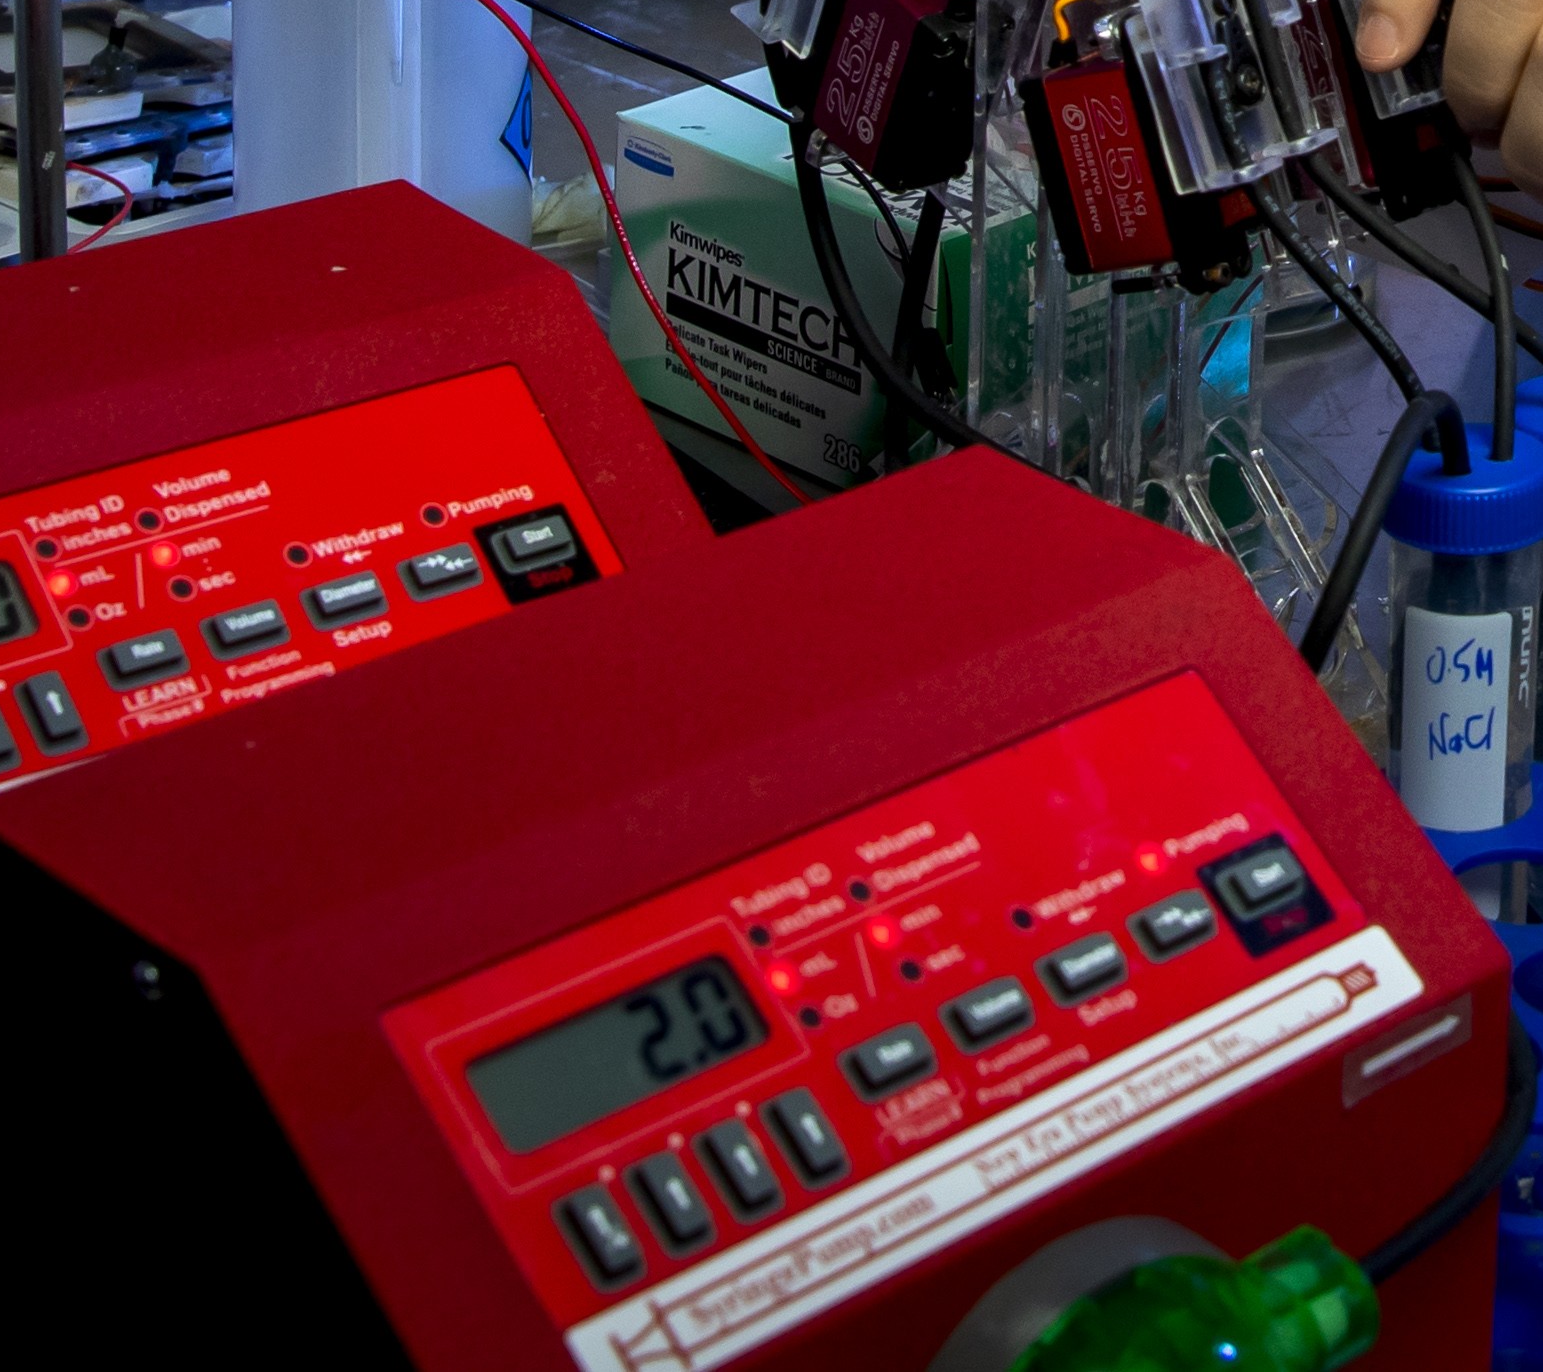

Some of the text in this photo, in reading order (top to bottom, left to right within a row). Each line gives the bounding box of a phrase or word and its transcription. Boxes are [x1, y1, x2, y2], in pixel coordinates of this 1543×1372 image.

[862, 62, 883, 115] DSSERVO
[870, 40, 900, 122] DIGITAL SERVO
[1070, 134, 1102, 233] DIGITAL SERVO
[1081, 133, 1102, 195] DSSERVO
[669, 220, 743, 268] Kimwipes
[708, 337, 730, 358] Task
[732, 347, 768, 375] Wipers
[767, 339, 856, 391] SCIENCE BRAND
[720, 383, 750, 406] tareas
[753, 399, 802, 429] delicadas
[721, 366, 742, 382] pour
[744, 373, 777, 399] tâches
[780, 389, 826, 420] délicates
[824, 433, 861, 474] 286
[152, 468, 231, 499] Volume
[163, 480, 271, 523] Dispensed
[447, 484, 534, 518] Pumping
[25, 494, 125, 534] Tubing ID
[521, 525, 554, 545] Start
[61, 522, 132, 552] inches
[182, 535, 222, 558] min
[311, 521, 405, 558] Withdraw
[78, 566, 115, 587] mL
[199, 570, 237, 593] sec
[95, 602, 128, 622] Oz
[224, 609, 275, 631] Volume
[332, 620, 393, 648] Setup
[220, 661, 336, 704] Programming
[225, 650, 302, 680] Function
[1426, 638, 1493, 686] 0.5M
[122, 676, 198, 713] LEARN
[1428, 707, 1496, 761] NaCl
[855, 820, 936, 864] Volume
[1162, 812, 1250, 858] Pumping
[730, 875, 810, 918] Tubing
[1033, 868, 1126, 919] Withdraw
[626, 969, 746, 1084] 2.0
[1077, 988, 1138, 1027] Setup
